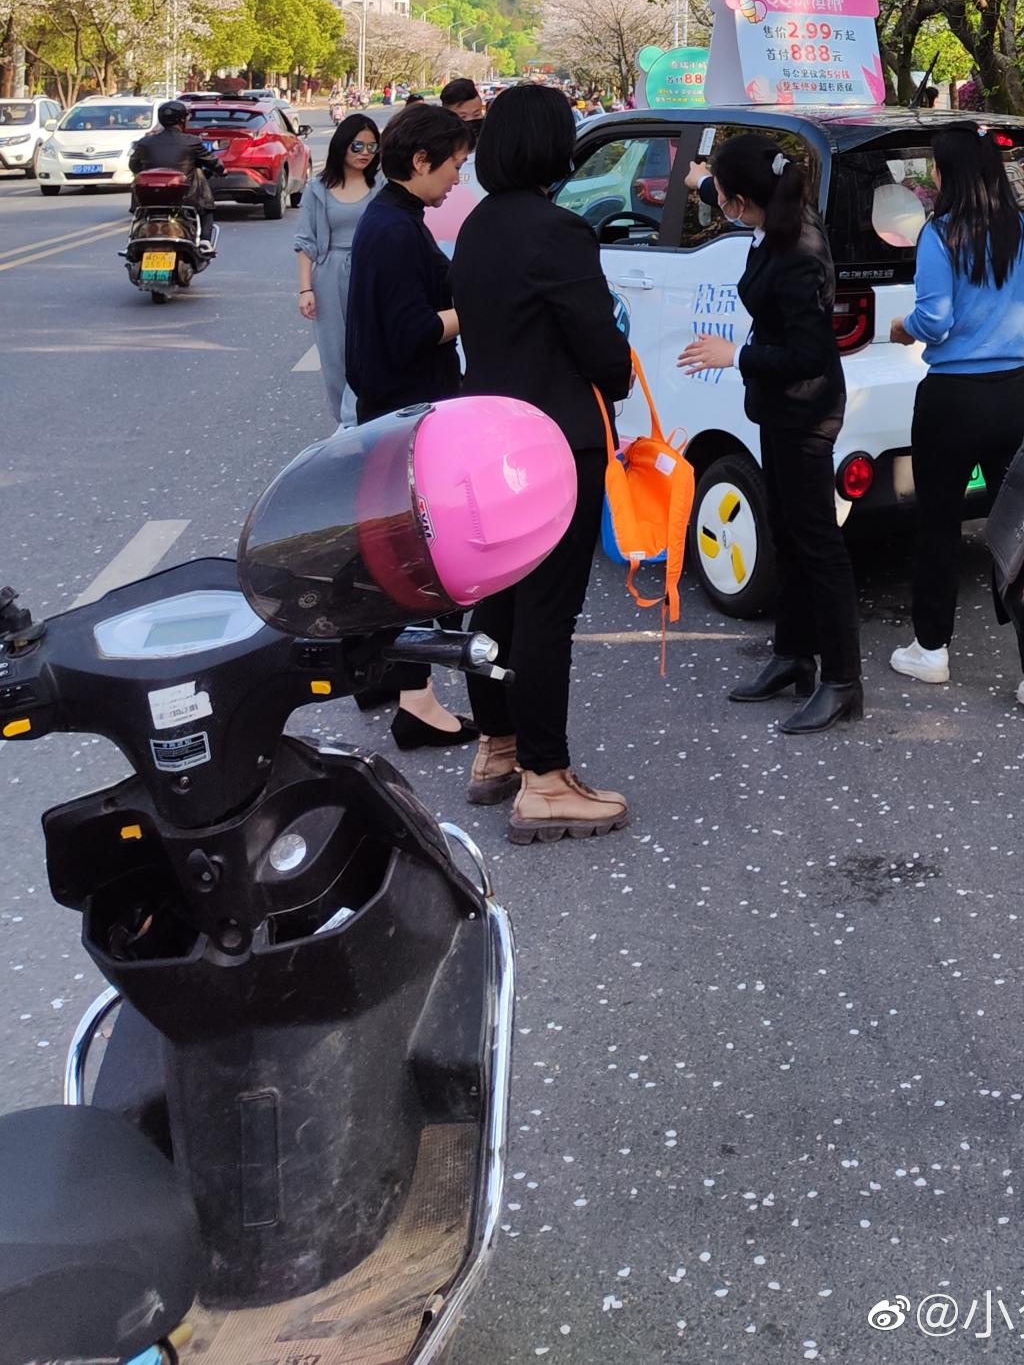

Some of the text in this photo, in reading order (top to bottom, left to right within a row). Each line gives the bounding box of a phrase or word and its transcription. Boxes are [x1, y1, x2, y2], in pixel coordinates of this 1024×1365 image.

[763, 22, 857, 42] 售价2.99万起
[766, 44, 845, 63] 首付888元
